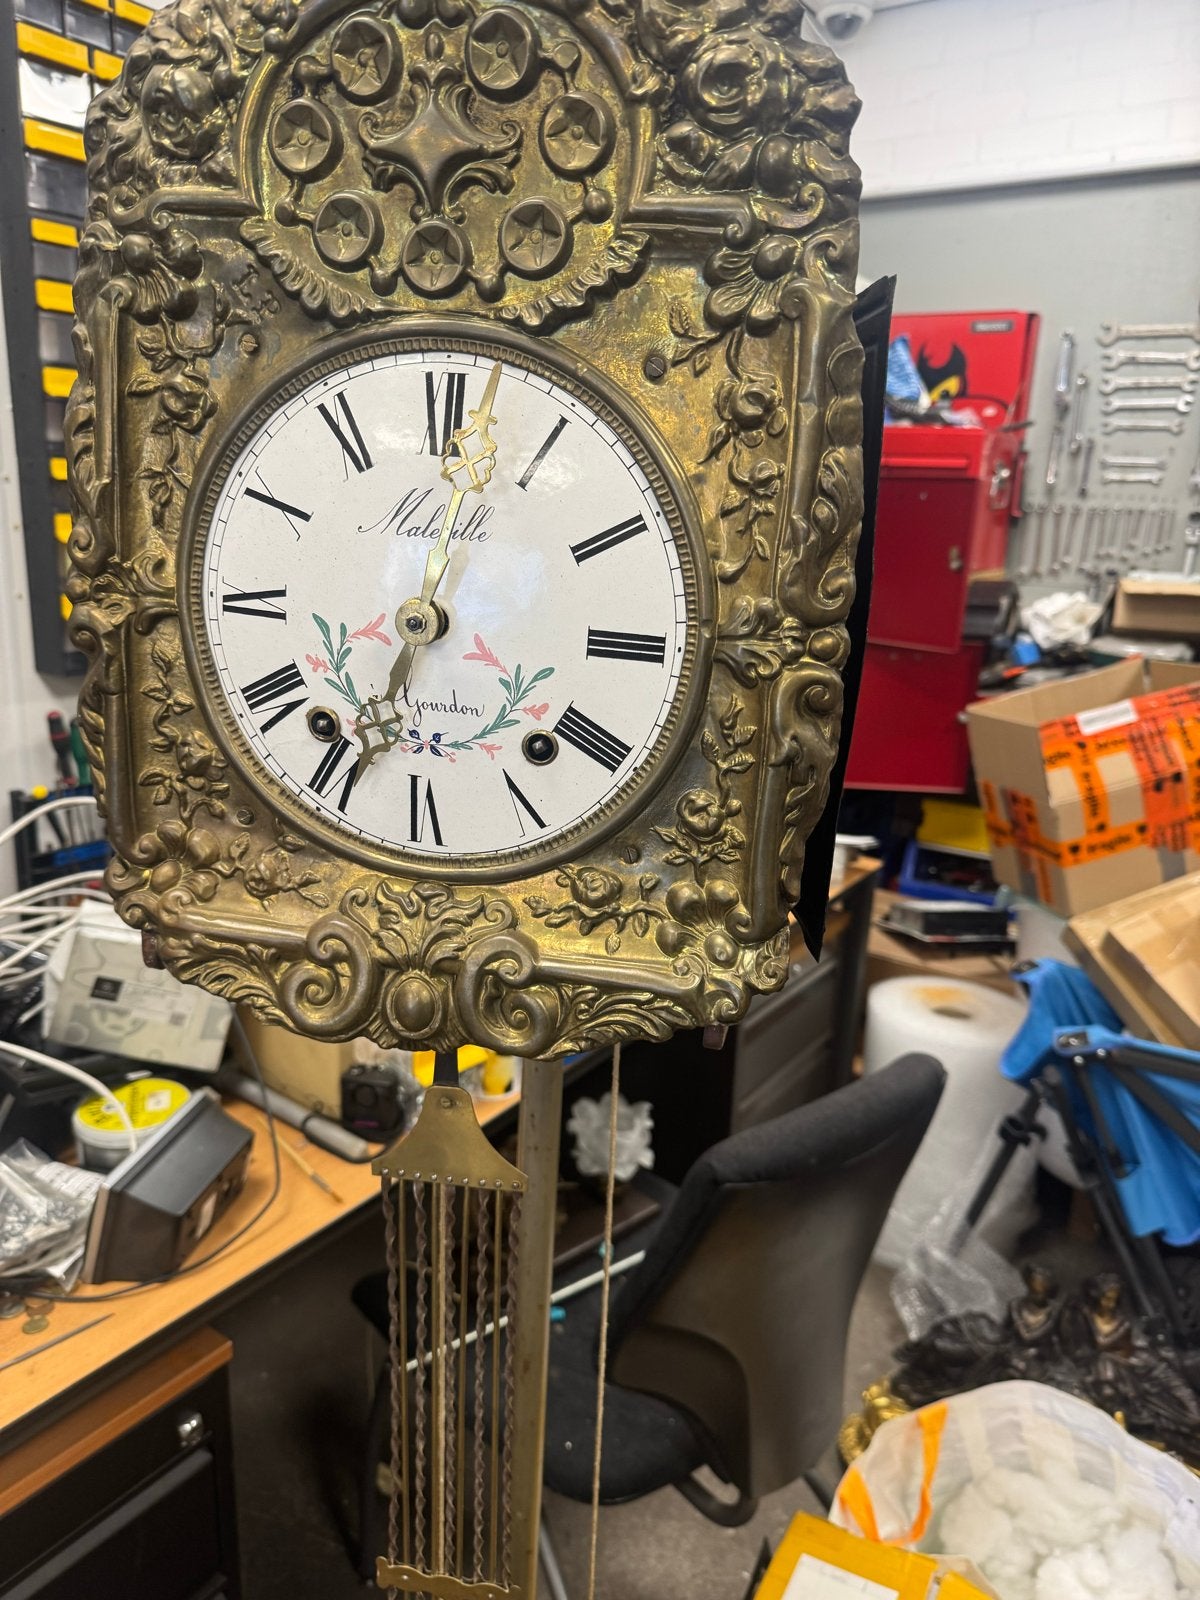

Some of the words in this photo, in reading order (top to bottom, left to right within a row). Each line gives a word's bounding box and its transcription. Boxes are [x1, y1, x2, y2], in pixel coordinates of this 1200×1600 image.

[314, 388, 377, 482] XI
[416, 371, 469, 458] XII
[515, 414, 572, 491] I
[241, 466, 314, 541] X
[357, 487, 495, 542] Maleille
[569, 510, 650, 566] II
[222, 576, 287, 625] IX
[586, 626, 667, 668] III
[239, 659, 310, 739] VIII
[394, 665, 484, 727] Gourdon
[305, 734, 361, 816] VII
[551, 700, 635, 777] IIII
[407, 774, 448, 847] VI
[502, 768, 551, 838] V
